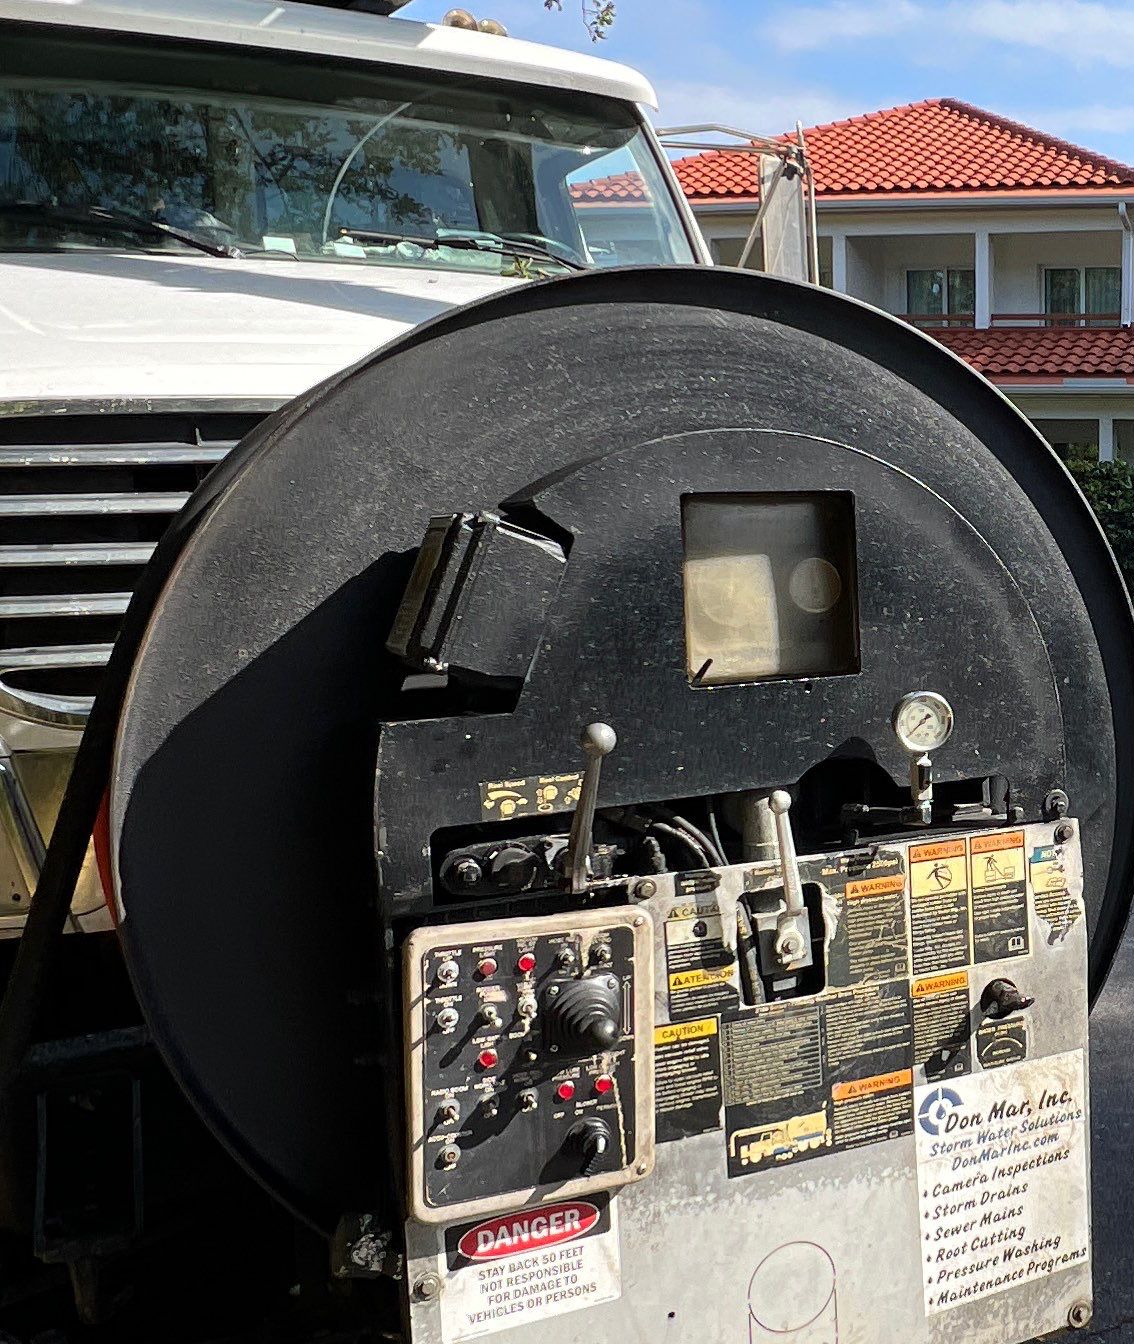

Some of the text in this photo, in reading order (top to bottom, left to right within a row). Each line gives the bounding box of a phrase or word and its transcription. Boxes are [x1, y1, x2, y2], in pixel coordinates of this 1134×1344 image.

[860, 880, 902, 892] WARNING
[925, 976, 966, 990] WARNING
[662, 1024, 704, 1039] CAUTION
[858, 1076, 901, 1092] WARNING
[944, 1089, 1072, 1133] Don Mar, Inc.
[929, 1108, 1082, 1157] Storm Water Solutions
[951, 1133, 1060, 1171] DonMarInc.com
[932, 1149, 1070, 1198] Camera Inspections
[932, 1181, 1029, 1220] Storm Drains
[476, 1208, 582, 1253] DANGER
[933, 1205, 1024, 1242] Sewer Mains
[478, 1245, 585, 1281] STAY BACK 50 FEET
[935, 1225, 1027, 1264] Root Cutting
[936, 1235, 1062, 1285] Pressure Washing
[479, 1258, 584, 1295] NOT RESPONSIBLE
[488, 1273, 578, 1306] FOR DAMAGE TO
[936, 1247, 1087, 1306] Maintenance Programs
[467, 1303, 525, 1325] VEHICLES
[527, 1296, 543, 1309] OR
[546, 1282, 597, 1305] PERSONS
